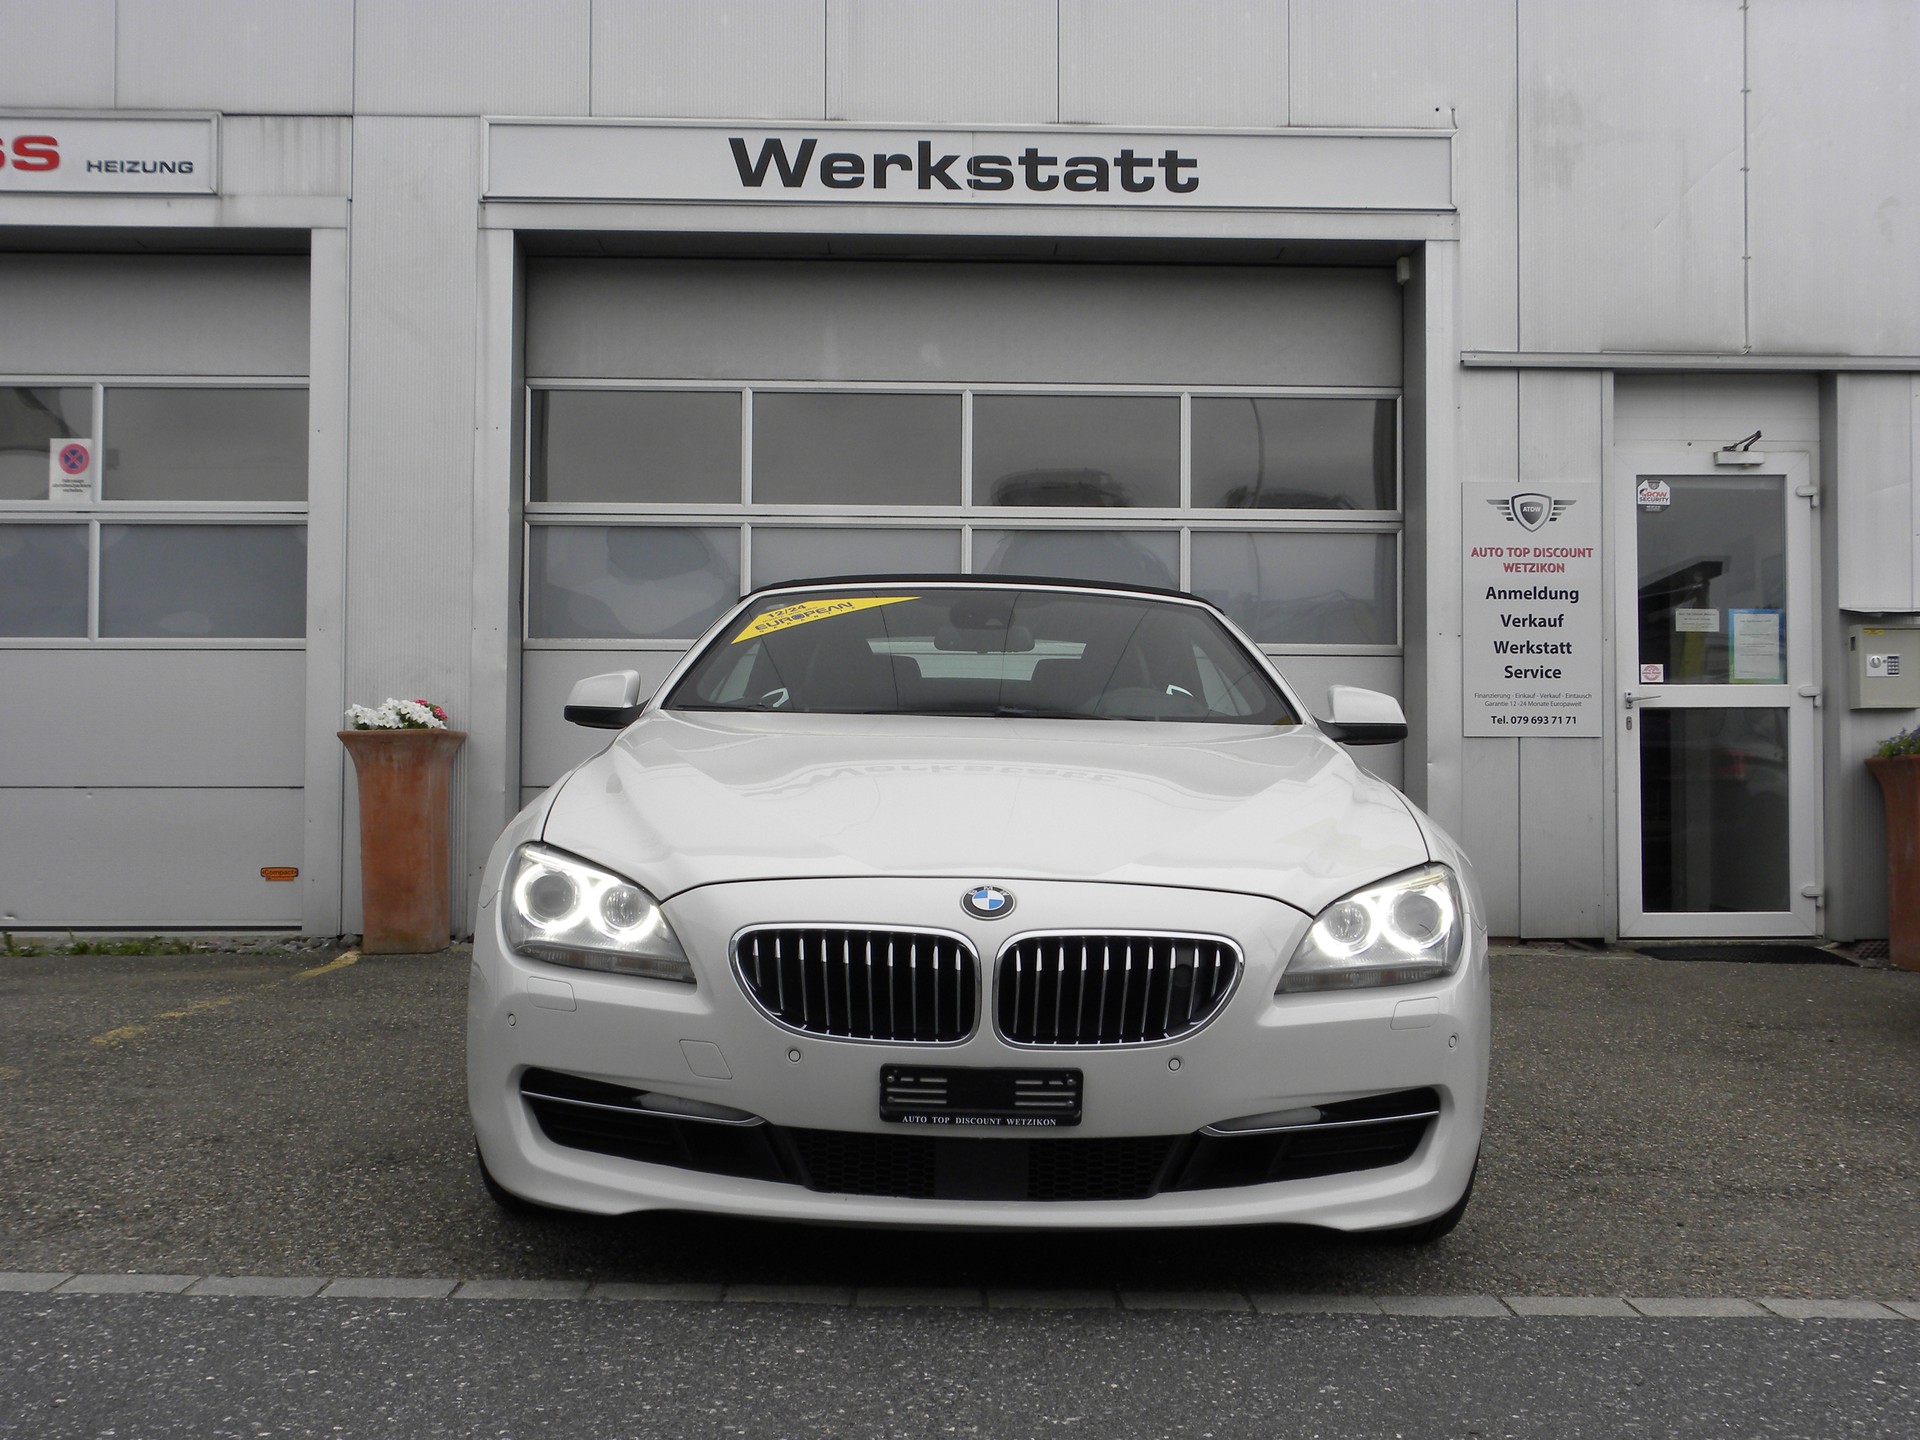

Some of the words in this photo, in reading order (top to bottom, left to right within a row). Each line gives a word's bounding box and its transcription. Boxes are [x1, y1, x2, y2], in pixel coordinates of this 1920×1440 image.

[0, 135, 60, 171] S
[86, 160, 194, 174] HEIZUNG
[727, 137, 1200, 194] Werkstatt
[1471, 547, 1504, 558] AUTO
[1507, 547, 1531, 558] TOP
[1533, 547, 1594, 558] DISCOUNT
[1503, 562, 1565, 573] WETZIKON
[1485, 586, 1580, 604] Anmeldung
[755, 601, 853, 631] EUROPEAN
[768, 604, 807, 619] 12/24
[1500, 613, 1565, 628] Verkauf
[1493, 640, 1573, 655] Werkstatt
[1504, 665, 1562, 679] Service
[1474, 692, 1511, 700] Finanzierung
[1491, 715, 1509, 725] Tel.
[1510, 715, 1529, 725] 079
[1530, 715, 1549, 725] 693
[1551, 716, 1562, 725] 71
[1566, 716, 1577, 725] 71
[902, 1115, 928, 1124] AUTO
[932, 1116, 950, 1124] TOP
[955, 1116, 1002, 1125] DISCOUNT
[1006, 1118, 1057, 1126] WETZIKON
